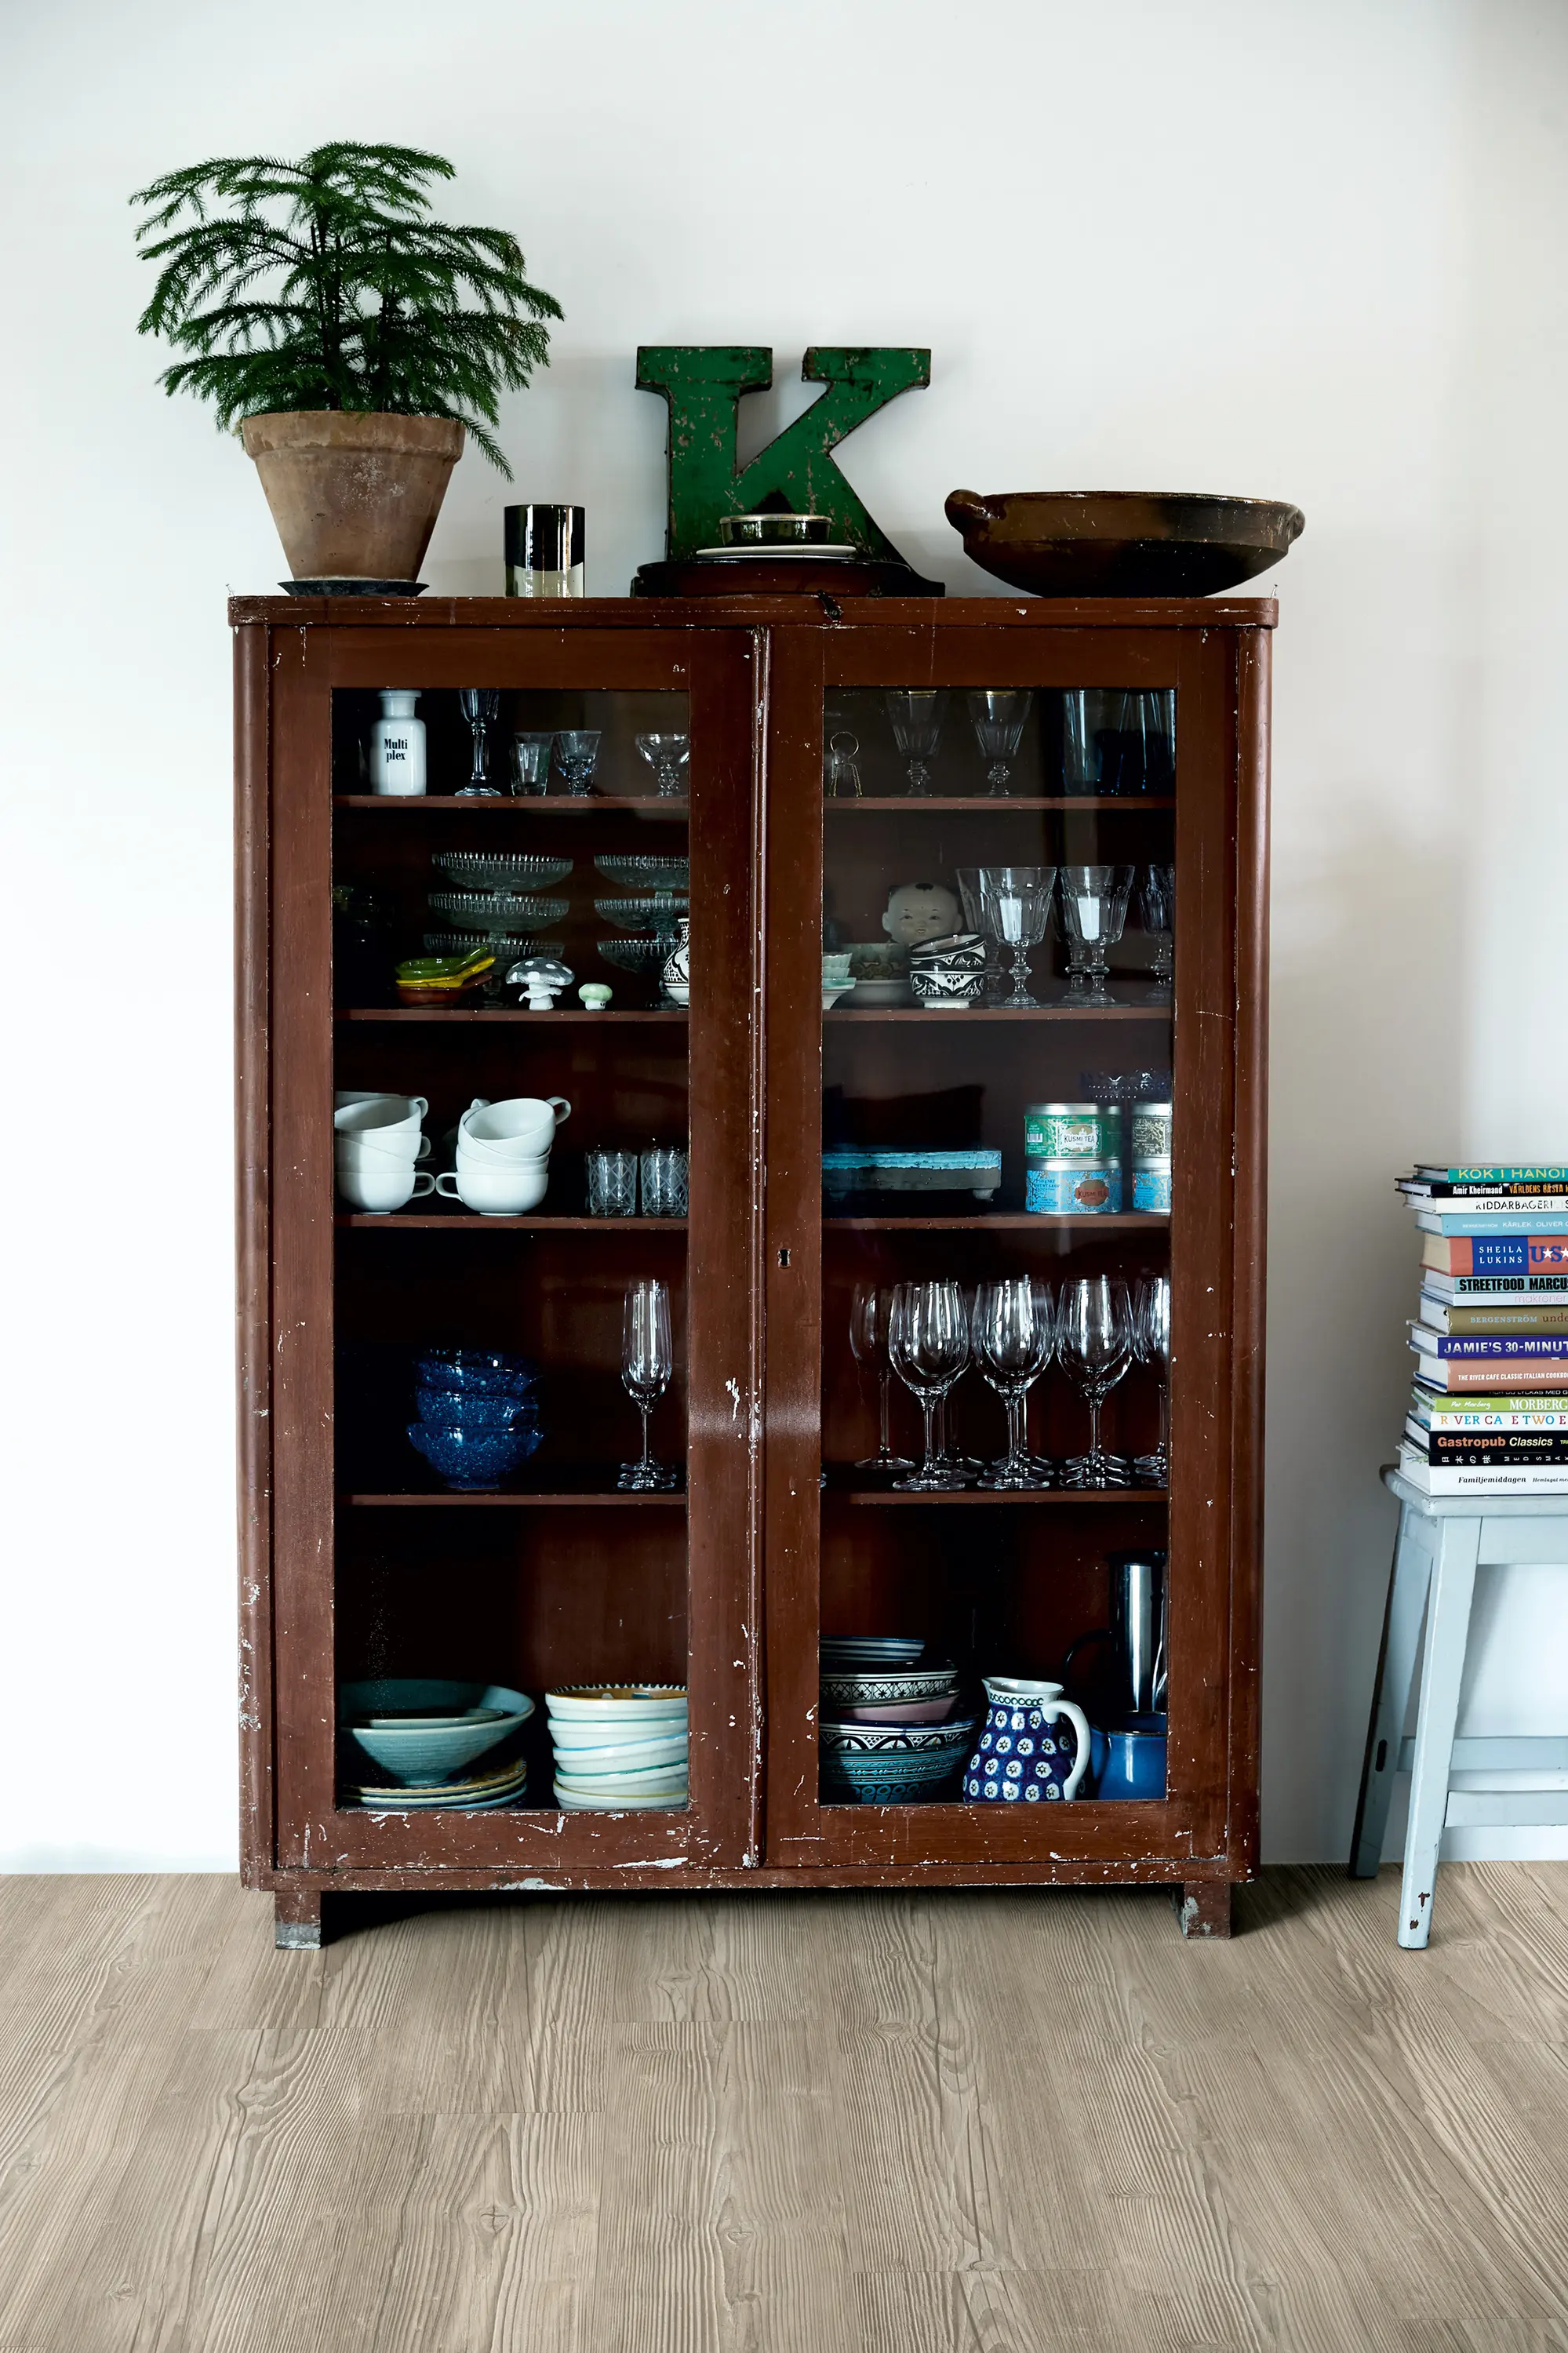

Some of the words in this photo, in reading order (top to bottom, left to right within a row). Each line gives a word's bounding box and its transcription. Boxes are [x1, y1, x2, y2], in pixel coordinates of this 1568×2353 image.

[630, 346, 945, 598] K
[384, 738, 408, 750] Multi
[386, 750, 406, 763] plex
[1064, 1135, 1083, 1144] KUSMI
[1501, 1169, 1504, 1179] I
[1512, 1168, 1566, 1179] HANOI
[1453, 1185, 1468, 1195] Amir
[1469, 1185, 1503, 1195] Kheirmand
[1459, 1278, 1525, 1292] STREETFOOD
[1529, 1278, 1568, 1290] MARCU
[1514, 1294, 1566, 1303] makroner
[1470, 1315, 1537, 1323] BERGENSTRÖM
[1444, 1342, 1502, 1354] JAMIE'S
[1464, 1400, 1491, 1410] Morberg
[1523, 1415, 1555, 1425] TWO
[1437, 1436, 1506, 1449] Gastropub
[1509, 1436, 1553, 1447] Classics
[1458, 1476, 1526, 1485] Familjemiddagen
